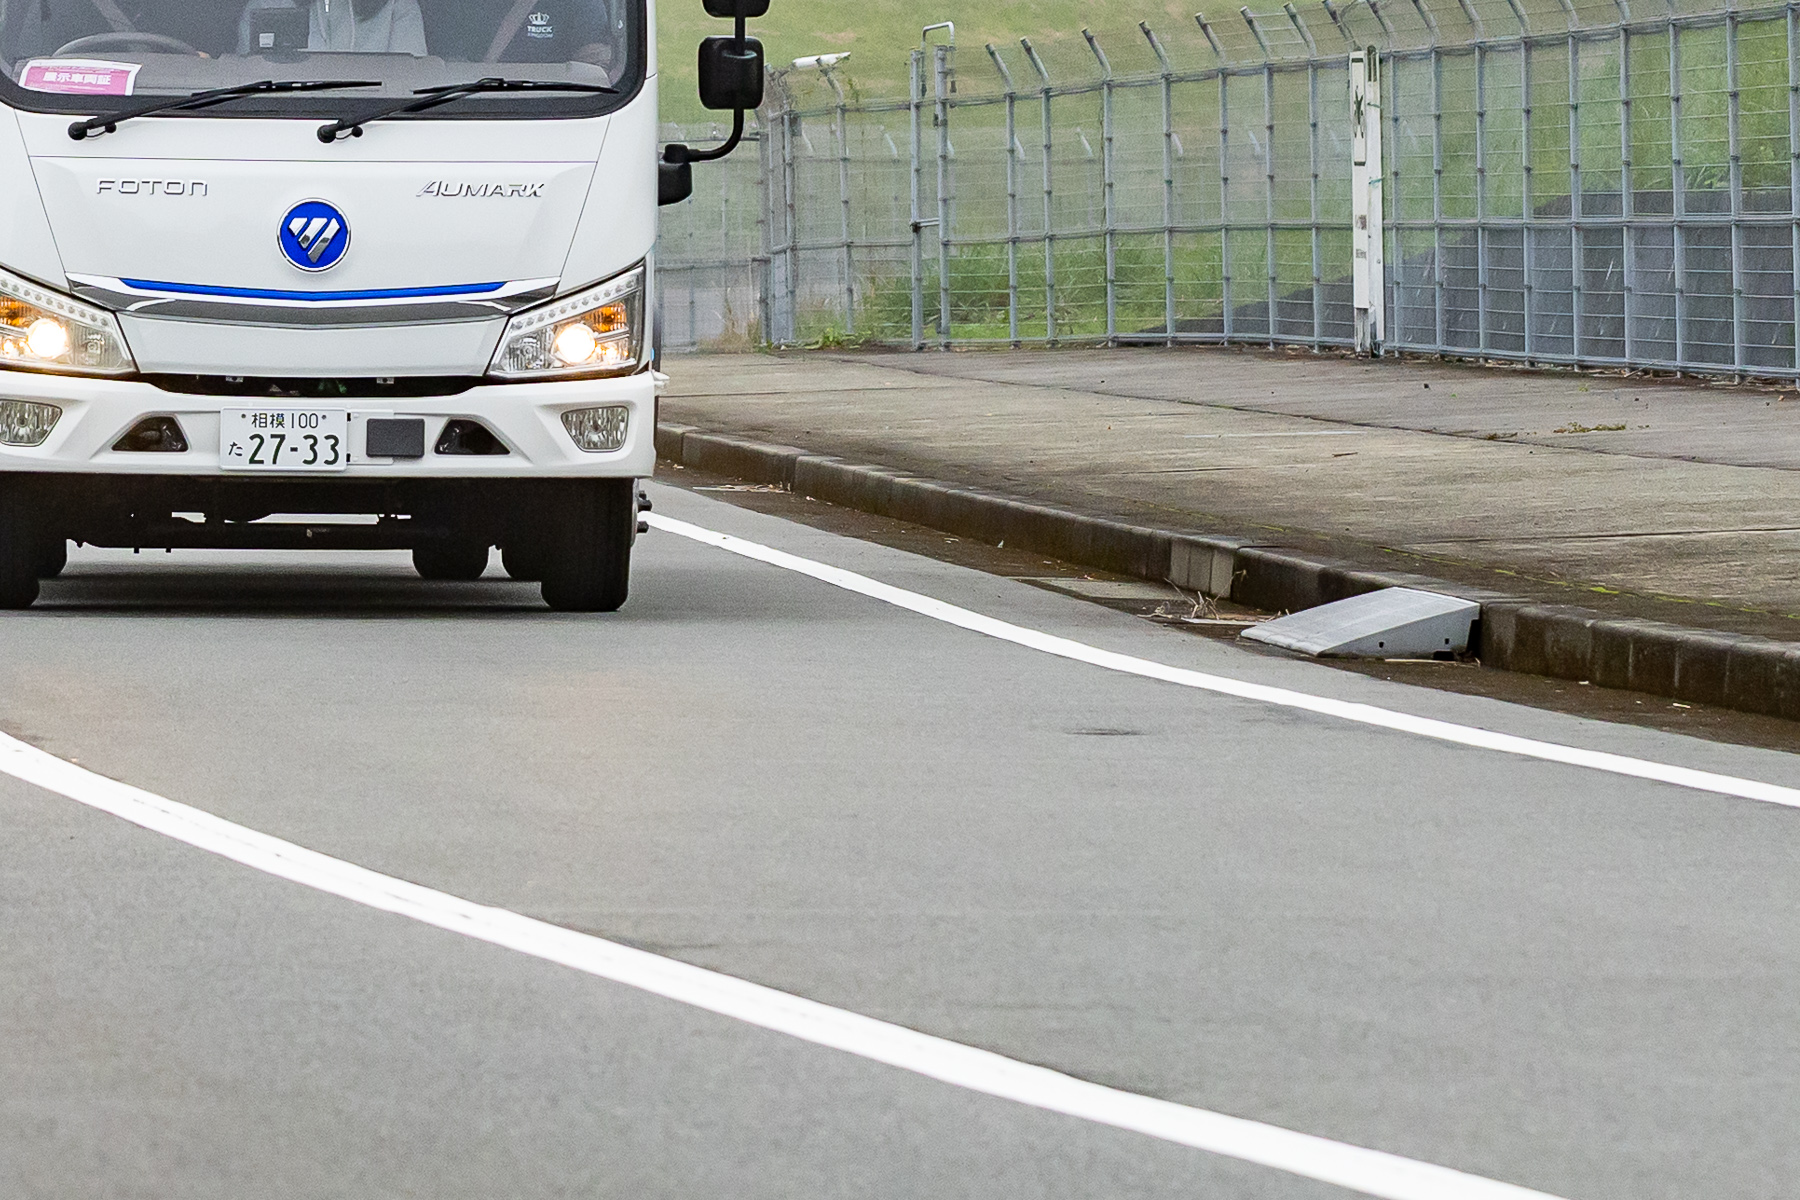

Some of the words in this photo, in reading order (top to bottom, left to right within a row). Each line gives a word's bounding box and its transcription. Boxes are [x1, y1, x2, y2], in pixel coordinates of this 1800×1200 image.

[527, 25, 553, 33] TRUCK
[97, 178, 208, 196] FOTON
[416, 180, 545, 197] AUMARK
[228, 441, 244, 457] た
[248, 433, 340, 465] 27-33
